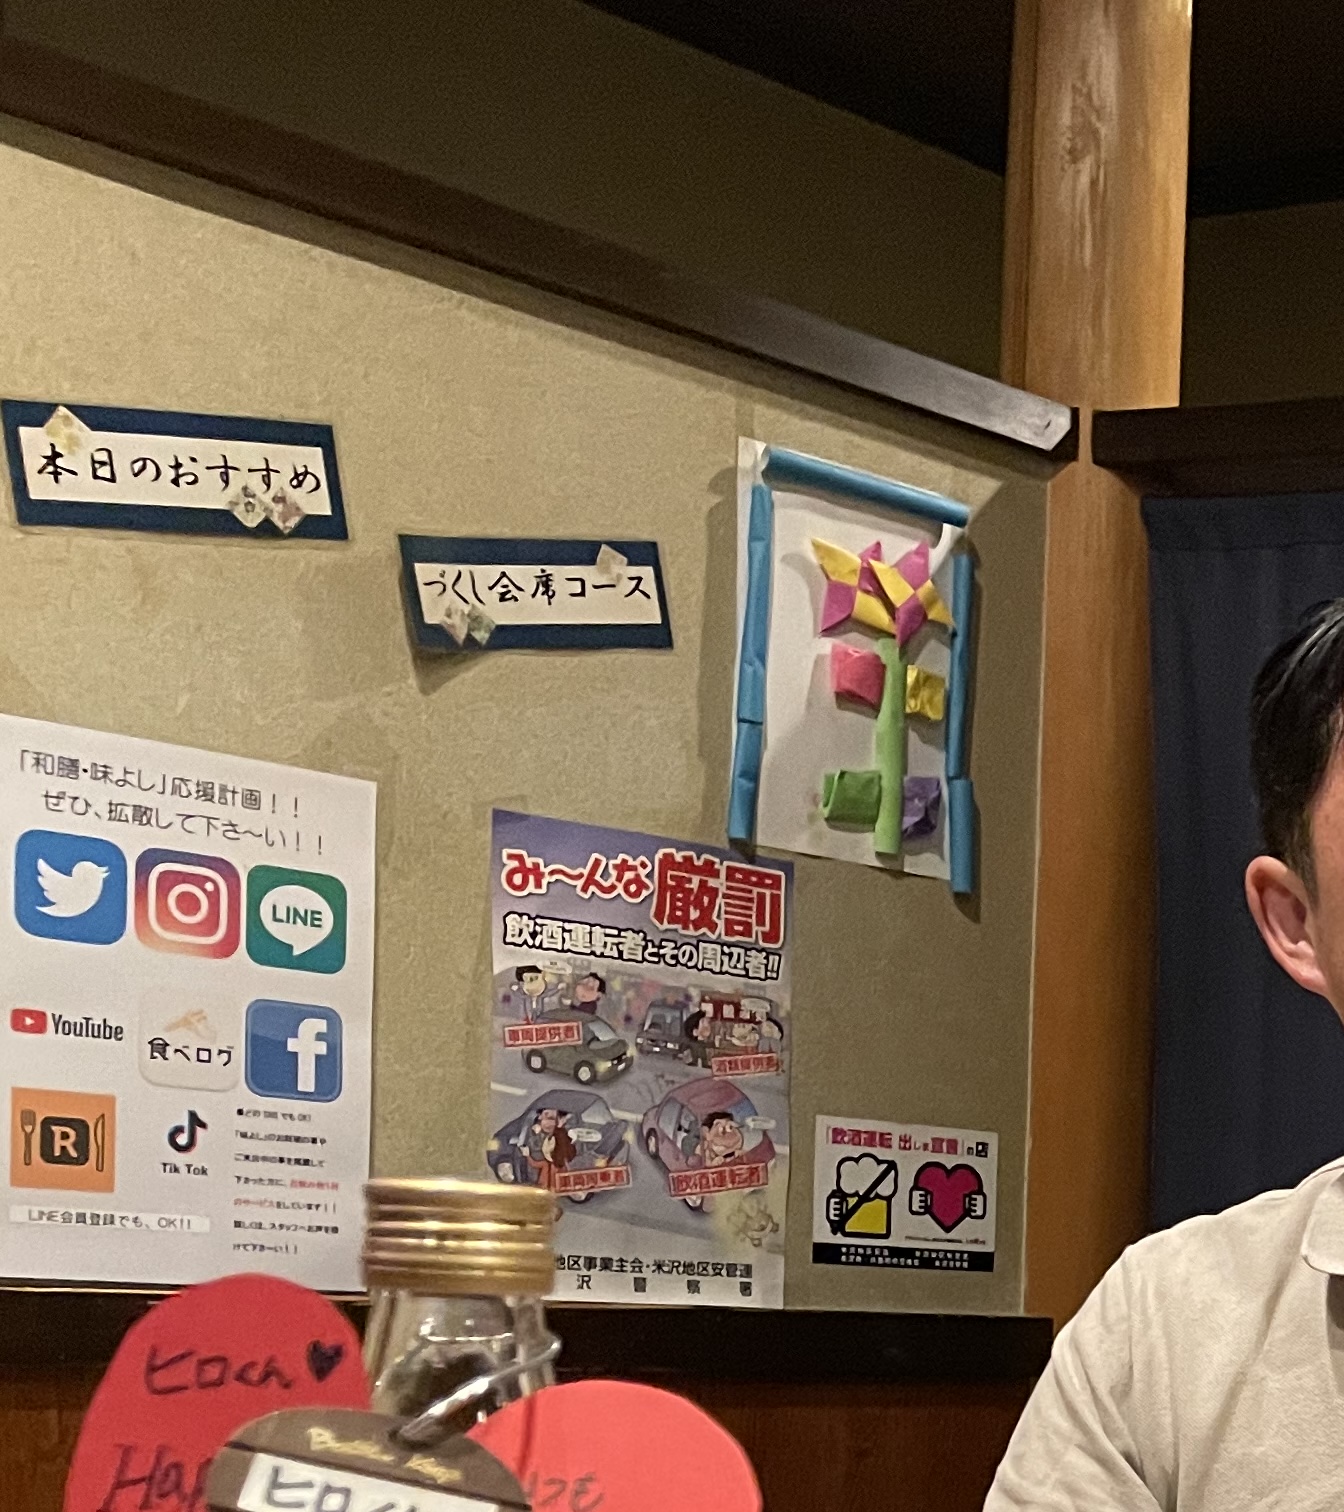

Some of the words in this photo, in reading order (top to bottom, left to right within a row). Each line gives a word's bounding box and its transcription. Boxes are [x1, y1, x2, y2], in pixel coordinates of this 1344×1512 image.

[37, 443, 321, 495] 本日のおすすめ
[423, 568, 652, 606] づくし会席コース
[272, 905, 323, 928] LINE
[51, 1013, 124, 1042] YouTube
[148, 1037, 234, 1067] 食べログ
[161, 1162, 181, 1175] Tik
[186, 1163, 208, 1177] Tok
[144, 1345, 293, 1395] ヒロくん
